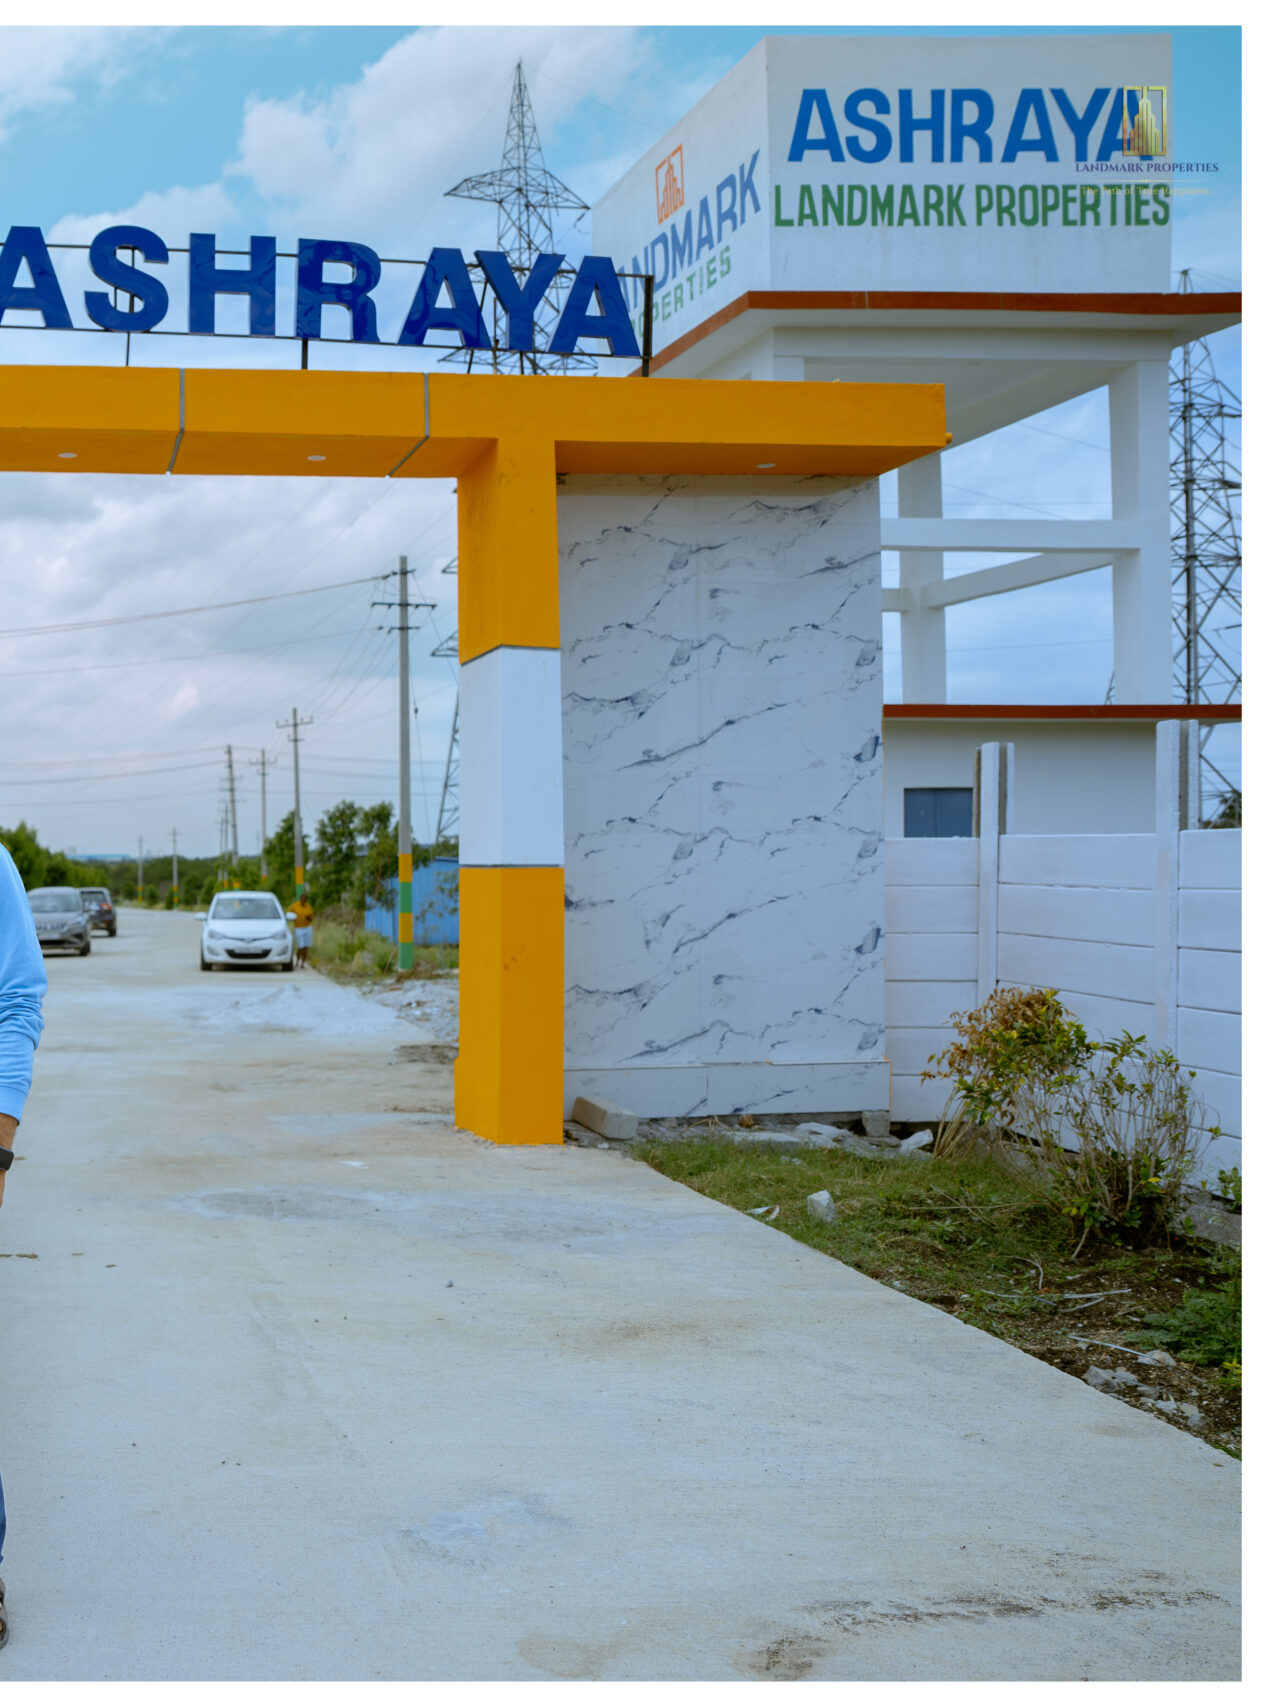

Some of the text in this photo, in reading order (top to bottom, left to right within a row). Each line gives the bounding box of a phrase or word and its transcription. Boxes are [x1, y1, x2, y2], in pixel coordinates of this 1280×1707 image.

[787, 87, 1154, 164] ASHRAYA
[774, 184, 1170, 227] LANDMARK PROPERTIES
